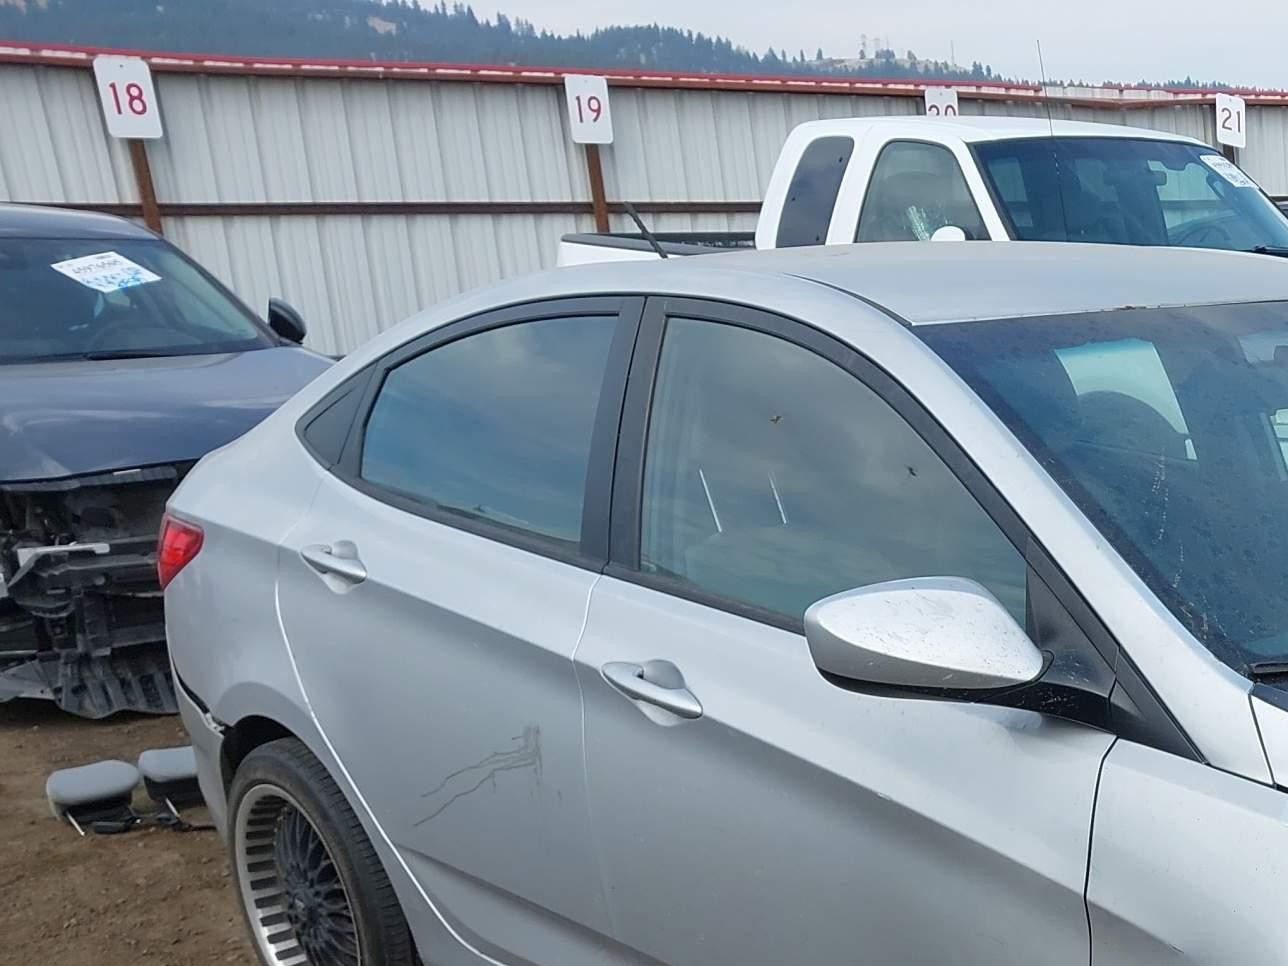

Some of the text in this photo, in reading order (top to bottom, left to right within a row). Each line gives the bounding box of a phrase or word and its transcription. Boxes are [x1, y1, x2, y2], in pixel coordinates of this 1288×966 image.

[109, 82, 147, 115] 18
[576, 95, 601, 123] 19
[1221, 107, 1241, 133] 21
